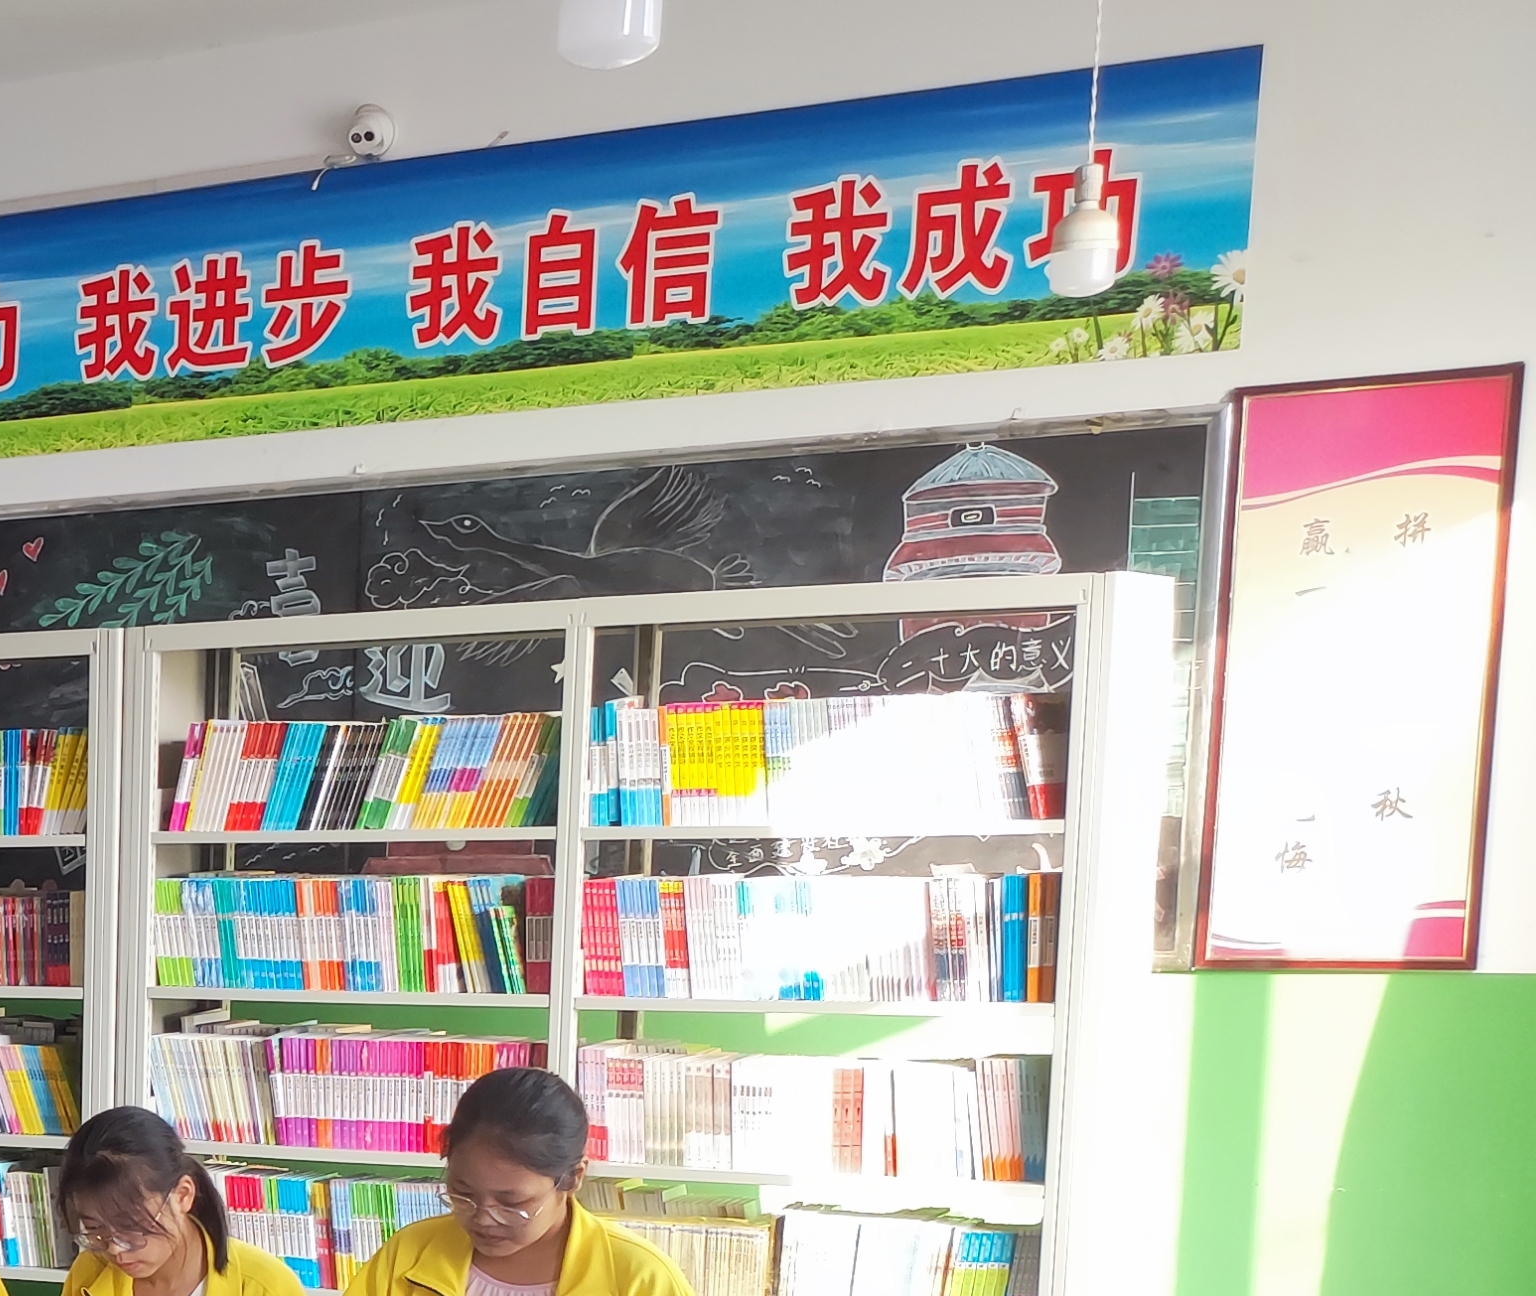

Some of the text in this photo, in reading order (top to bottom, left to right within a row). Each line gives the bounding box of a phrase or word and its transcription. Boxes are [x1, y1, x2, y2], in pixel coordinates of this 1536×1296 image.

[77, 243, 350, 378] 我进步
[408, 197, 720, 345] 我自信
[786, 148, 1140, 306] 我成功
[896, 636, 1072, 688] 二十大的意义
